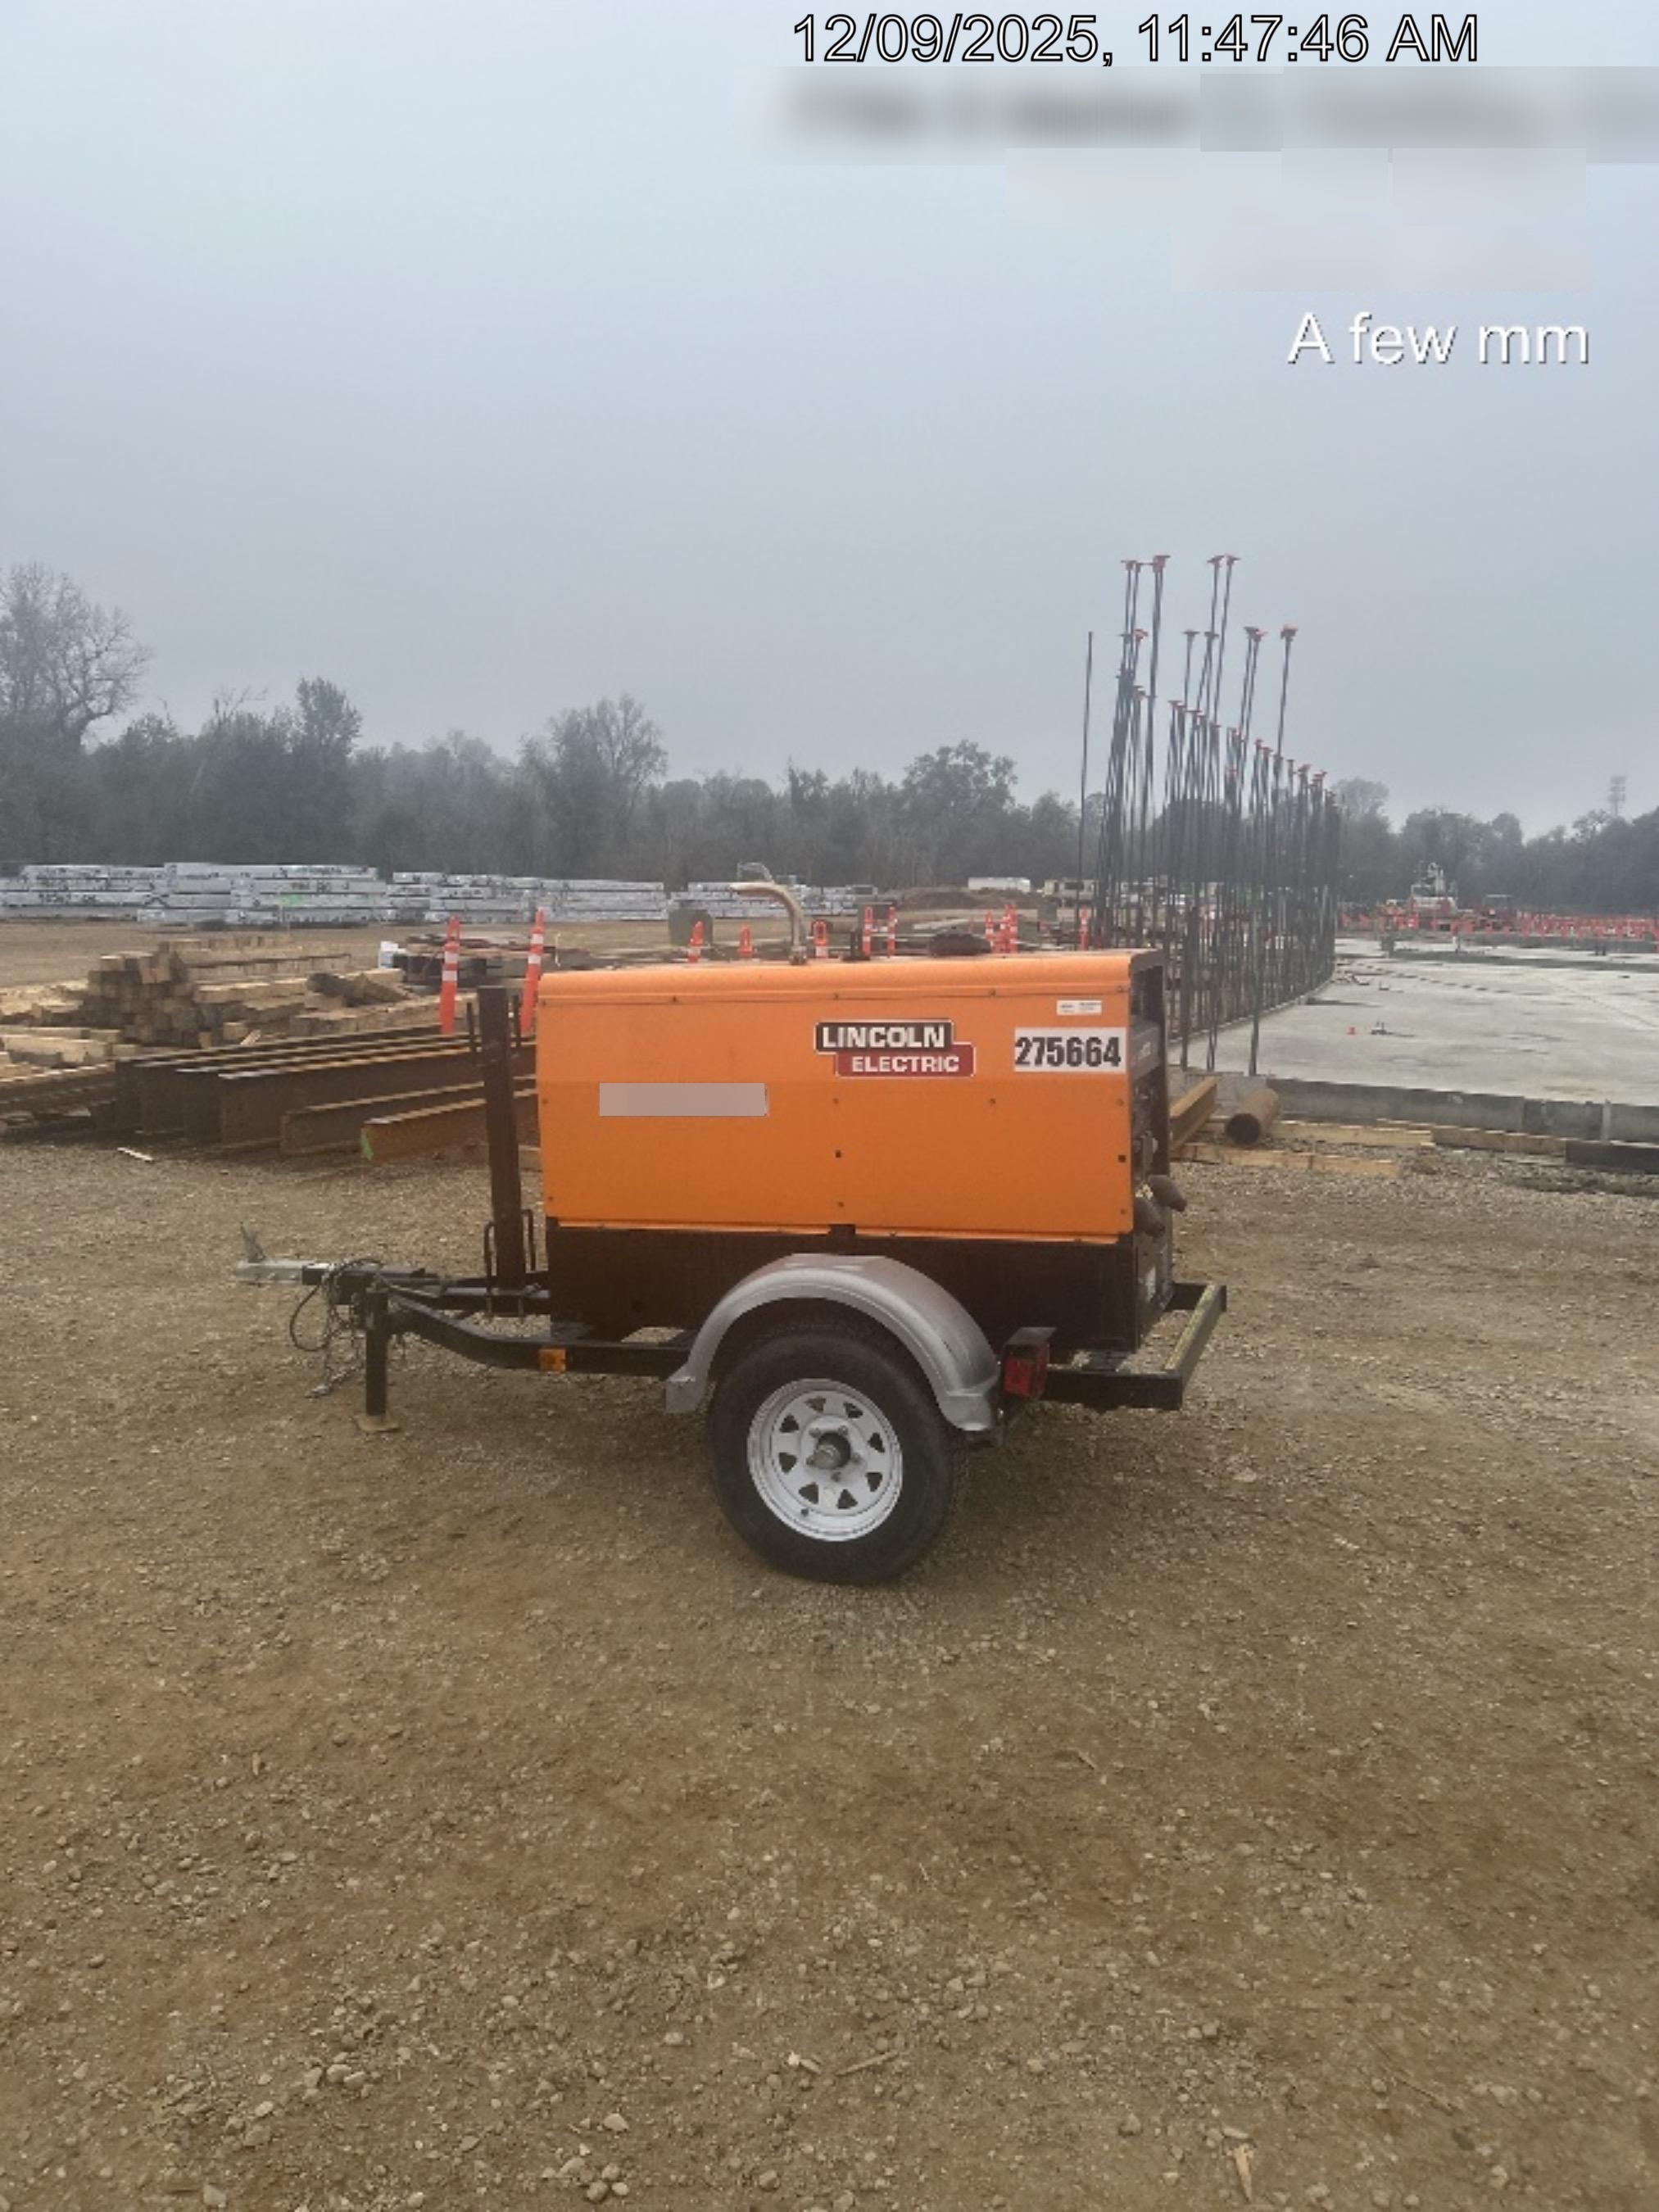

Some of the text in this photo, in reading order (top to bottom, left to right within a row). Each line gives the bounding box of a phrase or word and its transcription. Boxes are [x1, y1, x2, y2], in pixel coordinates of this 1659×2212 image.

[822, 1026, 945, 1048] LINCOLN
[1014, 1036, 1122, 1067] 275664
[851, 1055, 960, 1073] ELECTRIC
